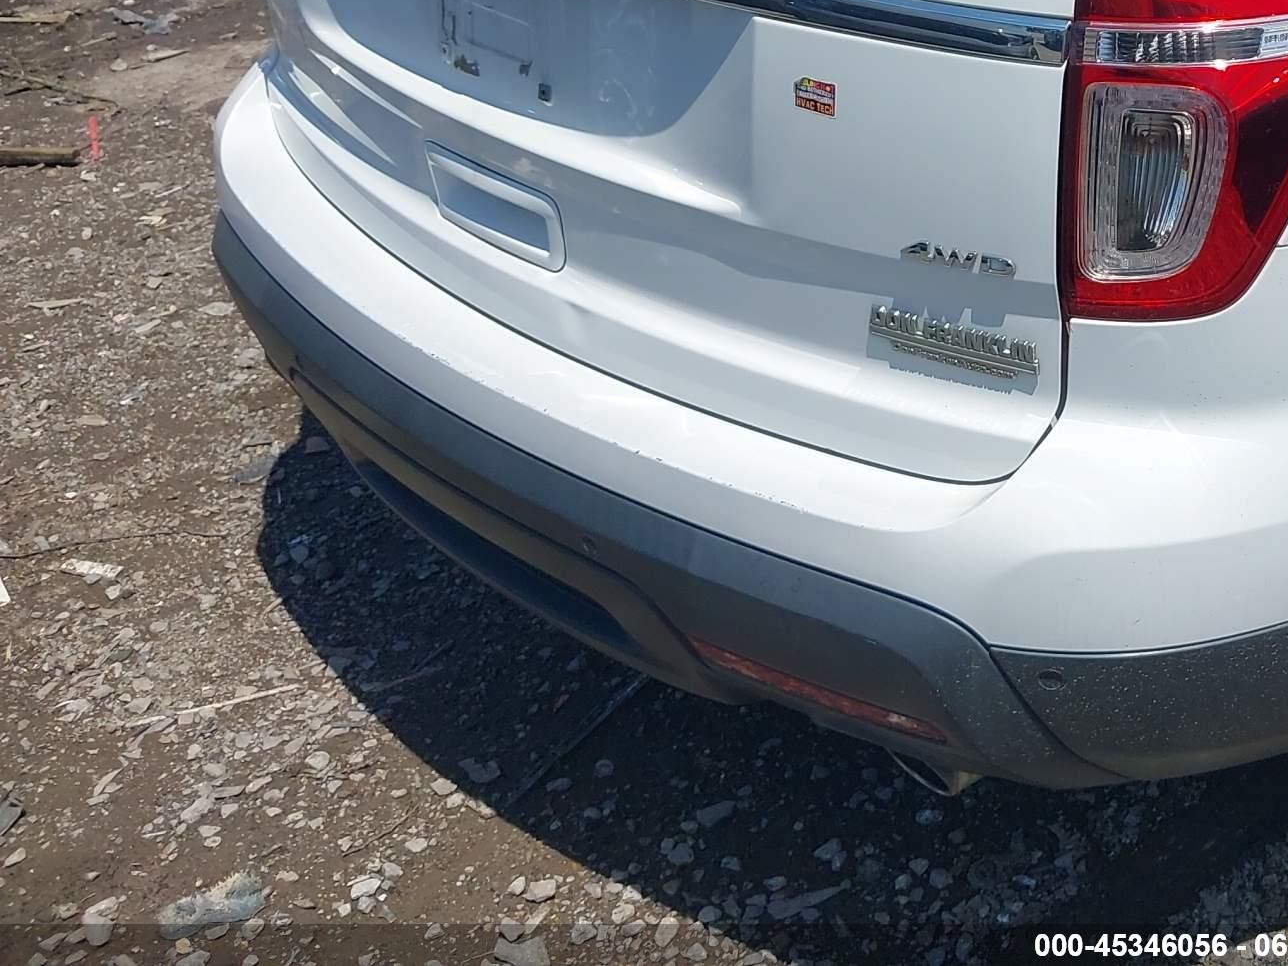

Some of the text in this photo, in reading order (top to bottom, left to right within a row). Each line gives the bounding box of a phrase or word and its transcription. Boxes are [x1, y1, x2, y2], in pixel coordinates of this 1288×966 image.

[796, 97, 815, 110] HVAC
[816, 103, 834, 115] TECH
[900, 240, 1016, 275] 4WD
[871, 306, 918, 332] DON
[923, 320, 1037, 363] FRANKLIN
